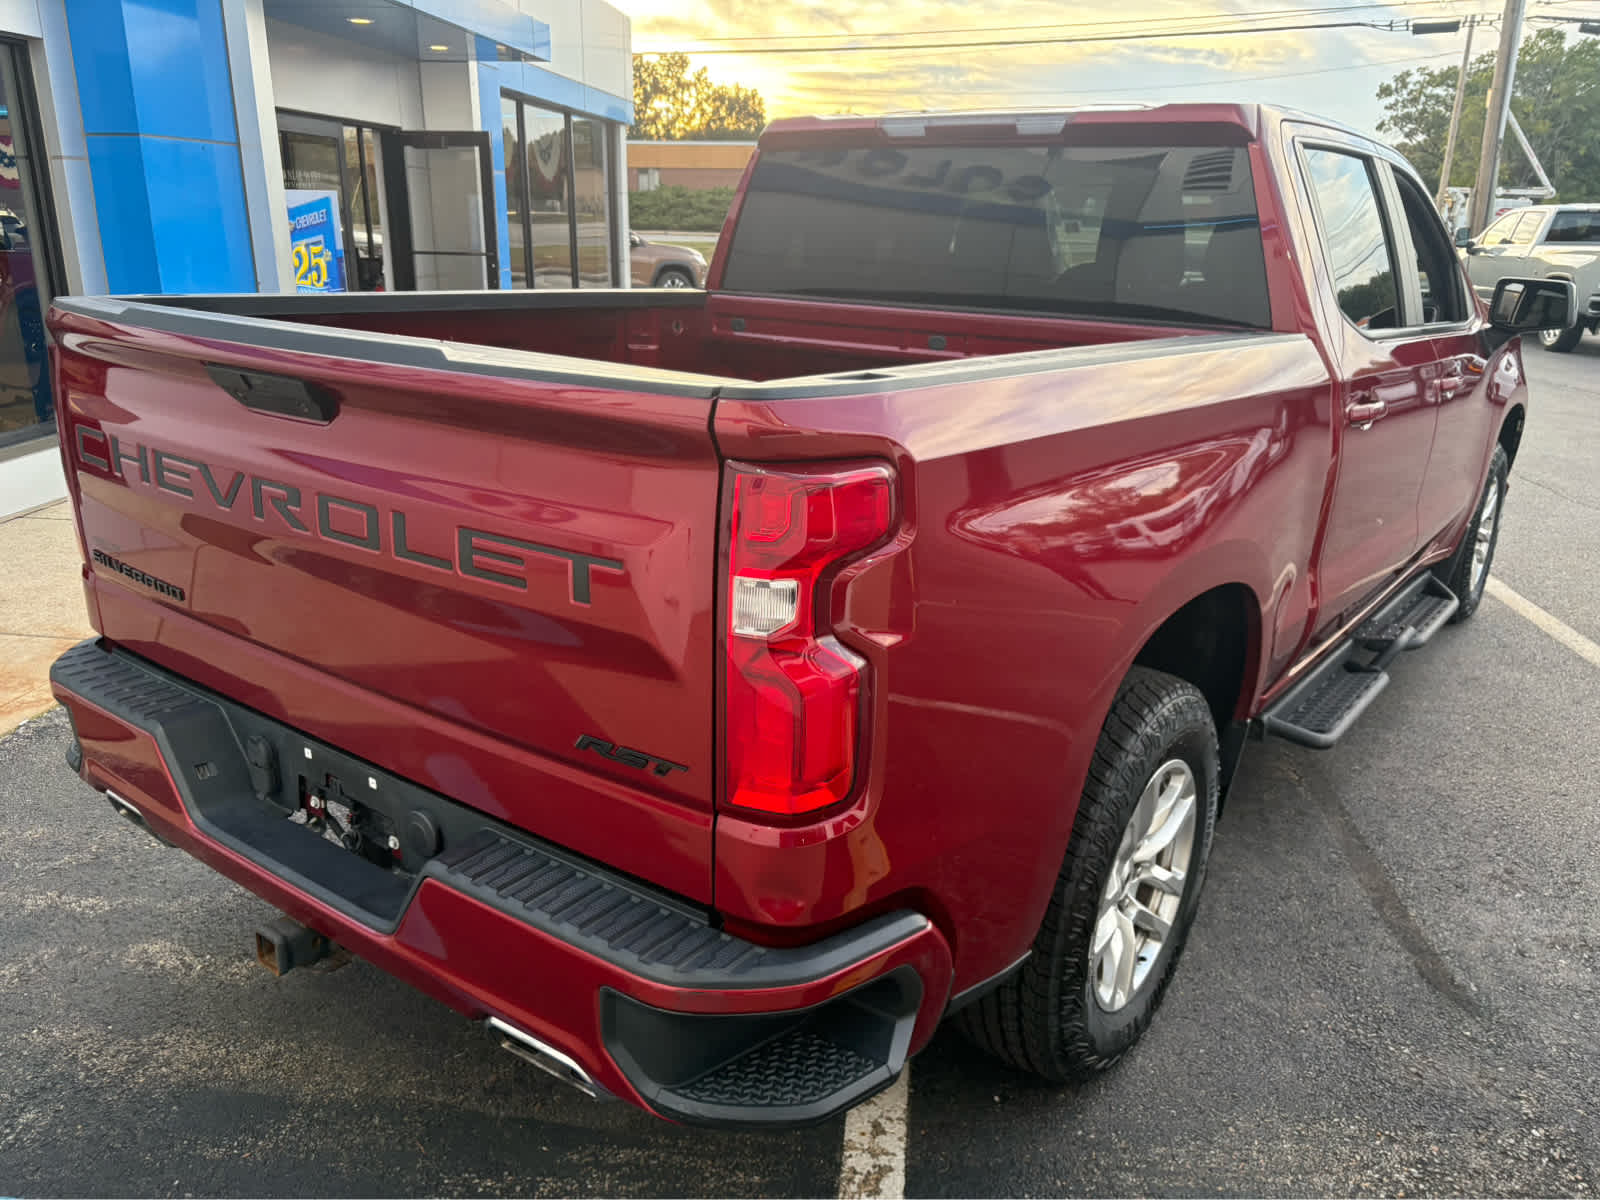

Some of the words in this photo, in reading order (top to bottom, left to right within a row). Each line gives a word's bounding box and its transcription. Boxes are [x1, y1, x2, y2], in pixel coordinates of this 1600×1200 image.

[295, 208, 328, 229] CHEVROLET
[76, 424, 625, 606] CHEVROLET
[93, 549, 185, 601] SILVERADO
[575, 734, 689, 776] RST
